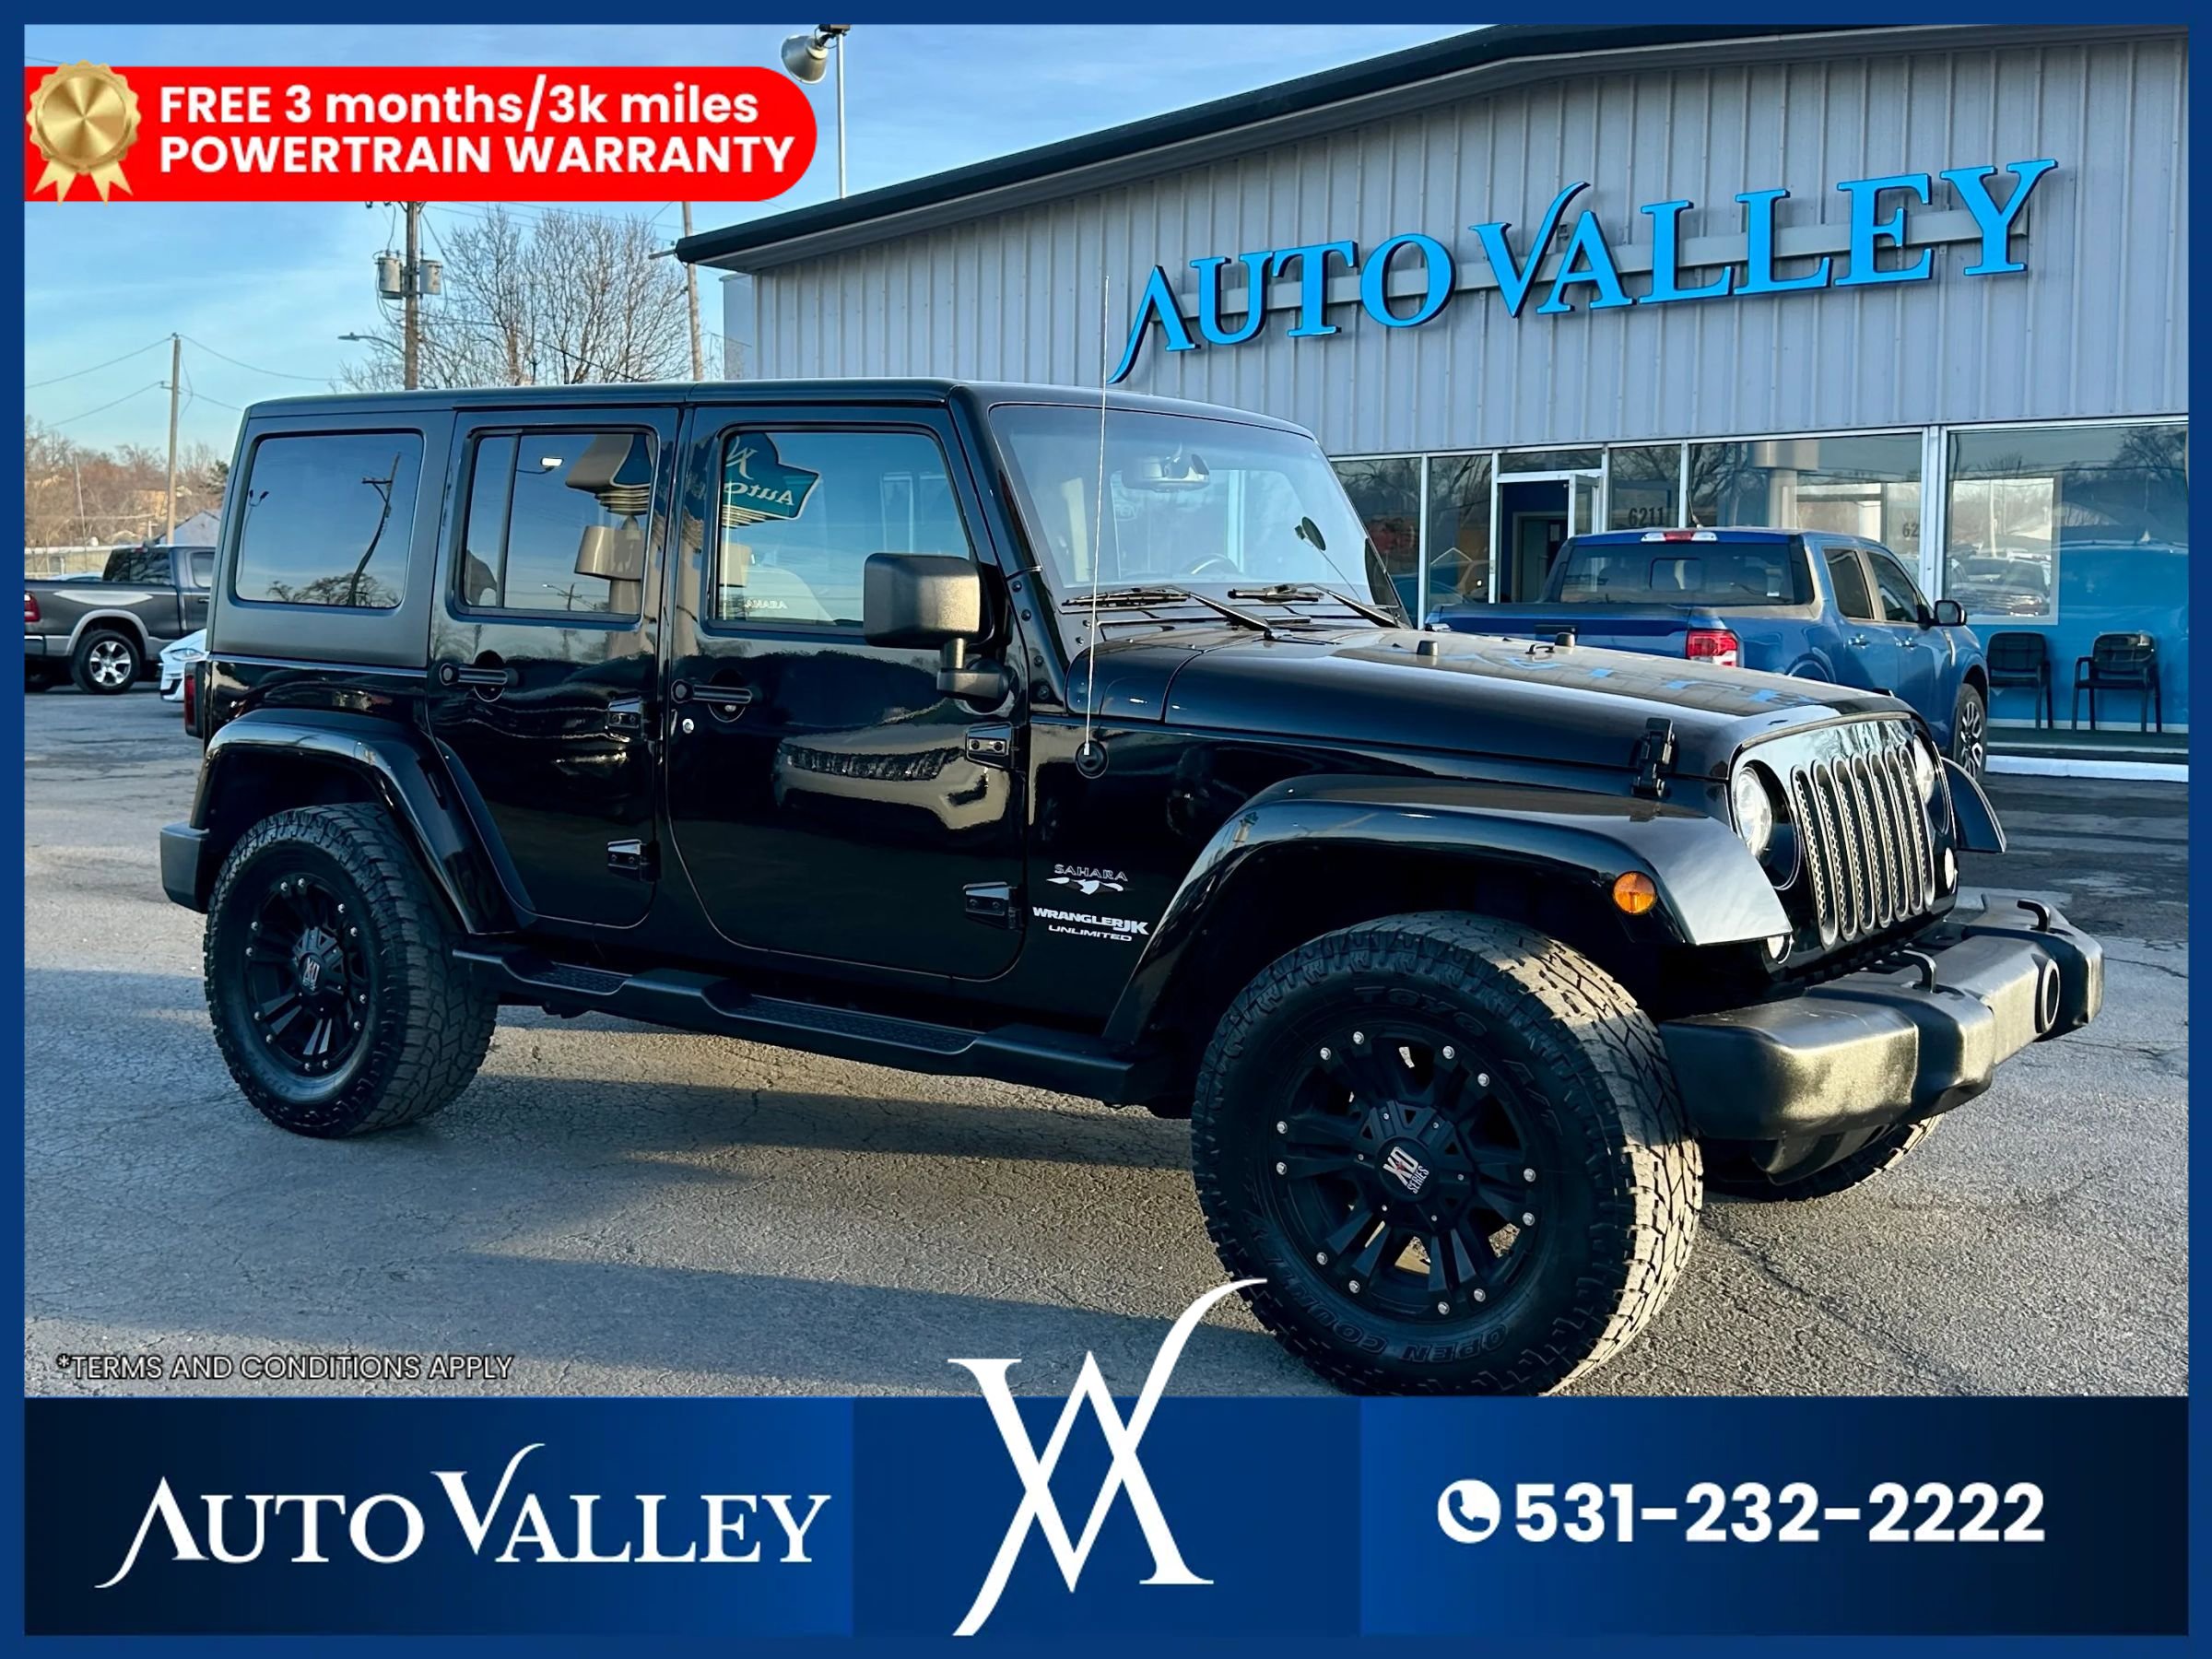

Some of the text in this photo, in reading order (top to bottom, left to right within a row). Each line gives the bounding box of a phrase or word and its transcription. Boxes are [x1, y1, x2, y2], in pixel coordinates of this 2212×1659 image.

[1108, 159, 2059, 384] AUTO VALLEY
[1629, 507, 1665, 527] 6211
[1054, 864, 1128, 882] SAHARA
[1048, 924, 1133, 942] UNLIMITED
[1382, 1146, 1419, 1187] XD
[1406, 1164, 1430, 1194] SERIES
[1399, 1323, 1510, 1363] OPEN
